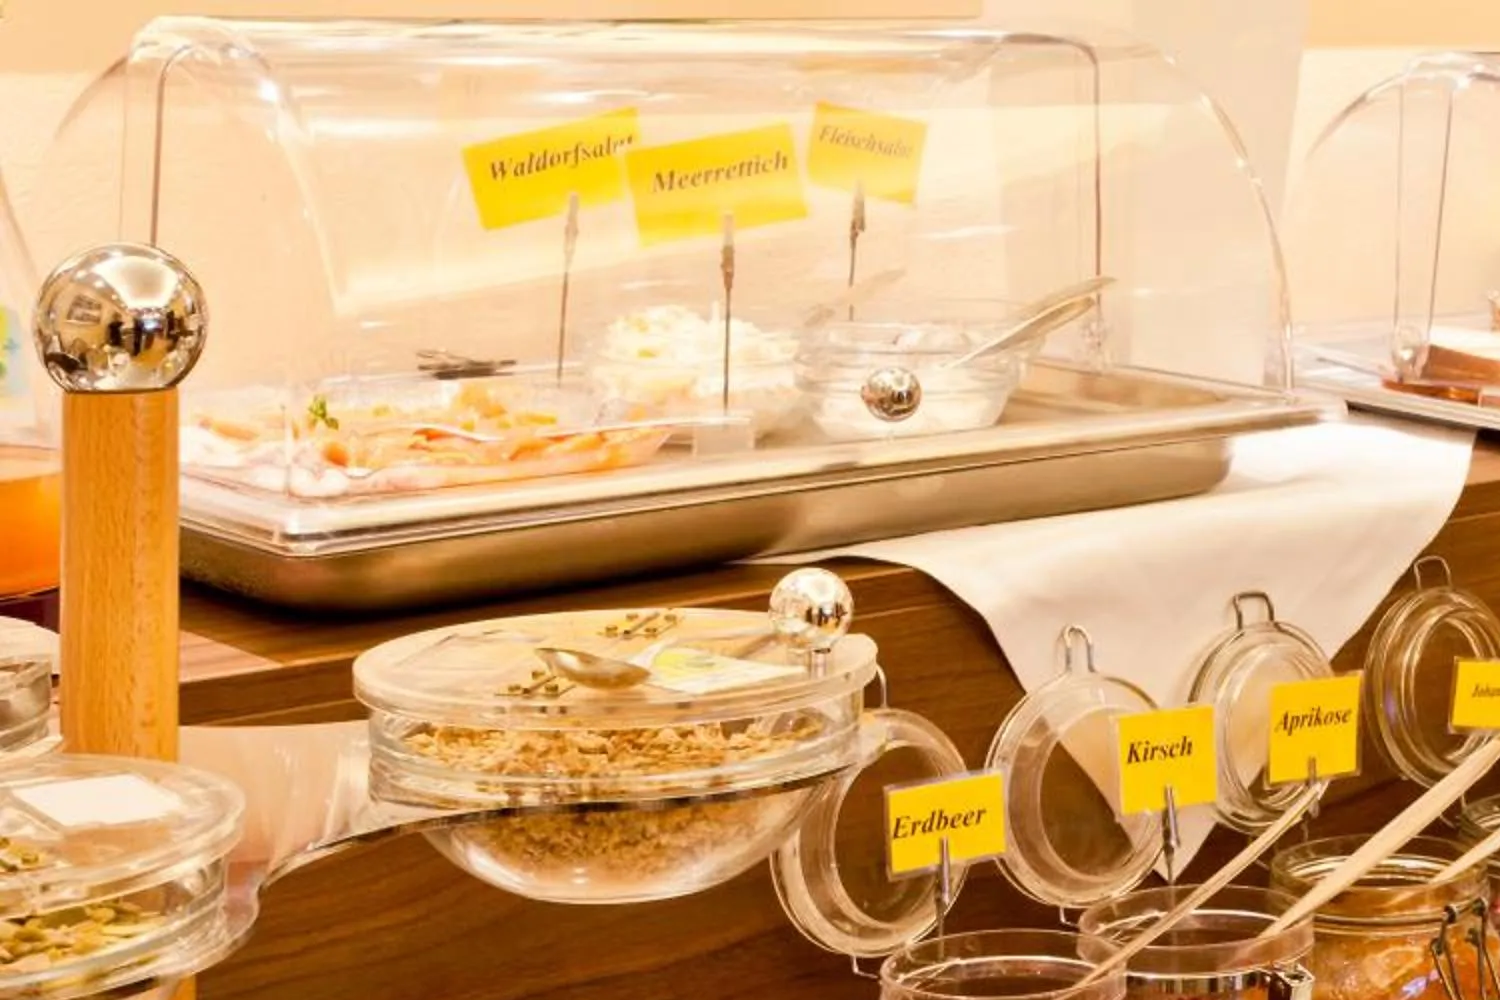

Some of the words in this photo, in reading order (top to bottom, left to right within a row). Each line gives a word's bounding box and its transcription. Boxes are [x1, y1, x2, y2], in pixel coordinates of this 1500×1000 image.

[653, 150, 788, 194] Meerrettich
[1275, 706, 1353, 735] Aprikose
[1126, 735, 1194, 765] Kirsch
[892, 806, 987, 840] Erdbeer
